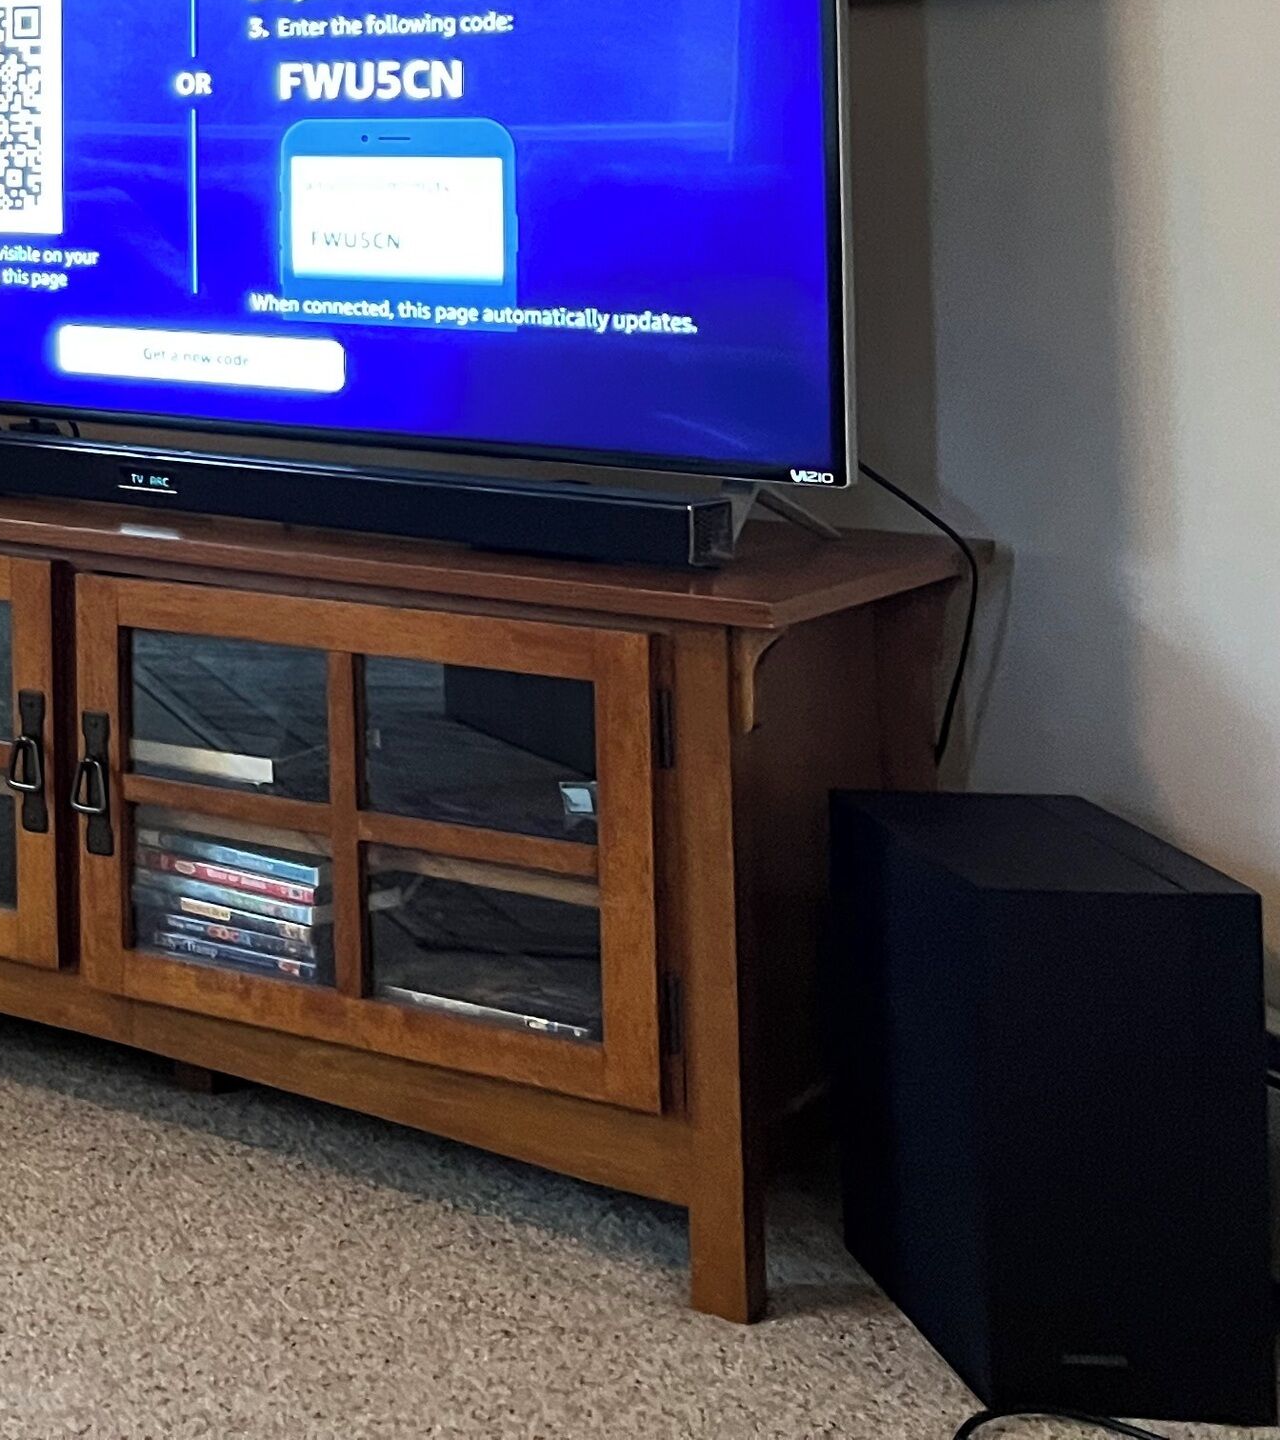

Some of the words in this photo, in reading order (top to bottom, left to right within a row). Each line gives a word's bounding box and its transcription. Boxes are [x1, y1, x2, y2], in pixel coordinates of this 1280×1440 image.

[248, 17, 270, 39] 3.
[276, 17, 328, 38] Enter
[331, 15, 363, 35] the
[365, 13, 456, 38] following
[460, 11, 514, 33] code:
[175, 70, 212, 97] OR
[278, 59, 464, 100] FWU5CN
[310, 230, 401, 250] FWU5CN
[43, 248, 62, 263] on
[65, 250, 100, 267] your
[2, 267, 29, 285] this
[31, 272, 68, 291] page
[249, 293, 300, 312] When
[302, 297, 395, 320] connected,
[398, 300, 431, 320] this
[434, 304, 480, 327] page
[482, 307, 609, 333] automatically
[612, 312, 698, 336] updates.
[131, 473, 144, 484] TV
[790, 469, 834, 484] VIZIO
